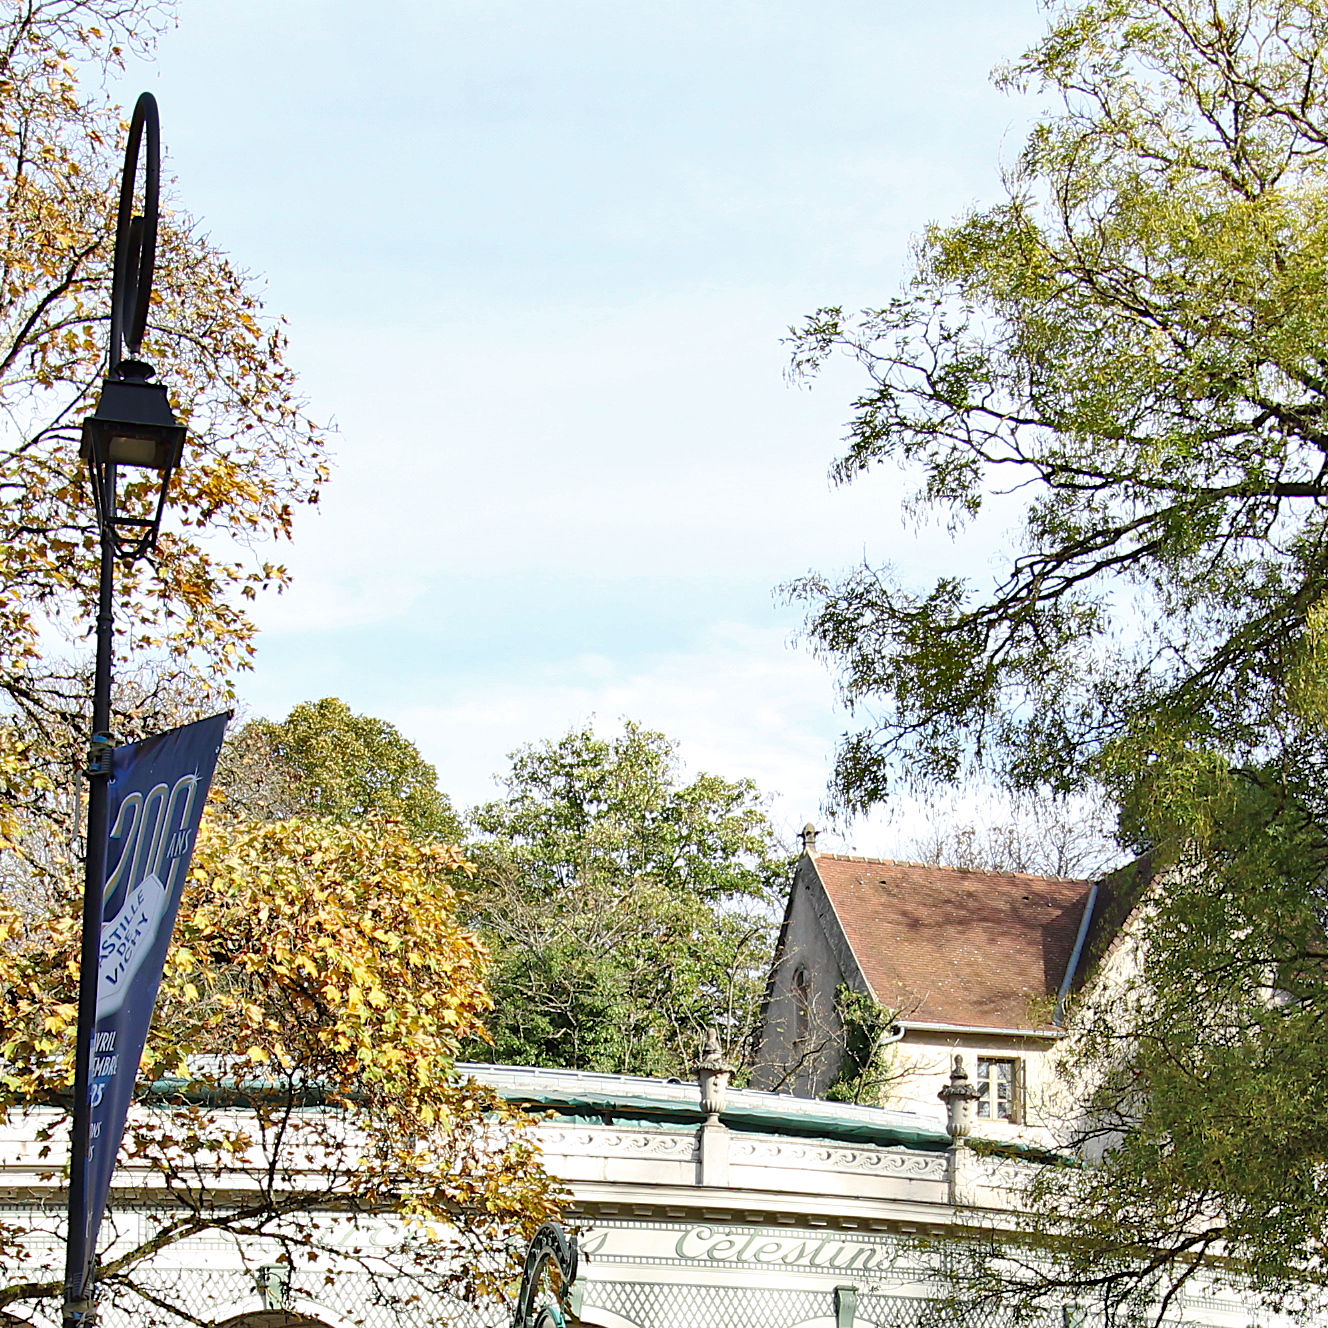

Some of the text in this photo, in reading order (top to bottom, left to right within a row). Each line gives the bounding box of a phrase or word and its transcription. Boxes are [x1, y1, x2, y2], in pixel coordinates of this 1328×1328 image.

[103, 774, 197, 910] 200 ANS
[100, 889, 144, 968] ASTILLE
[105, 912, 148, 986] VICHY
[117, 930, 133, 956] DE
